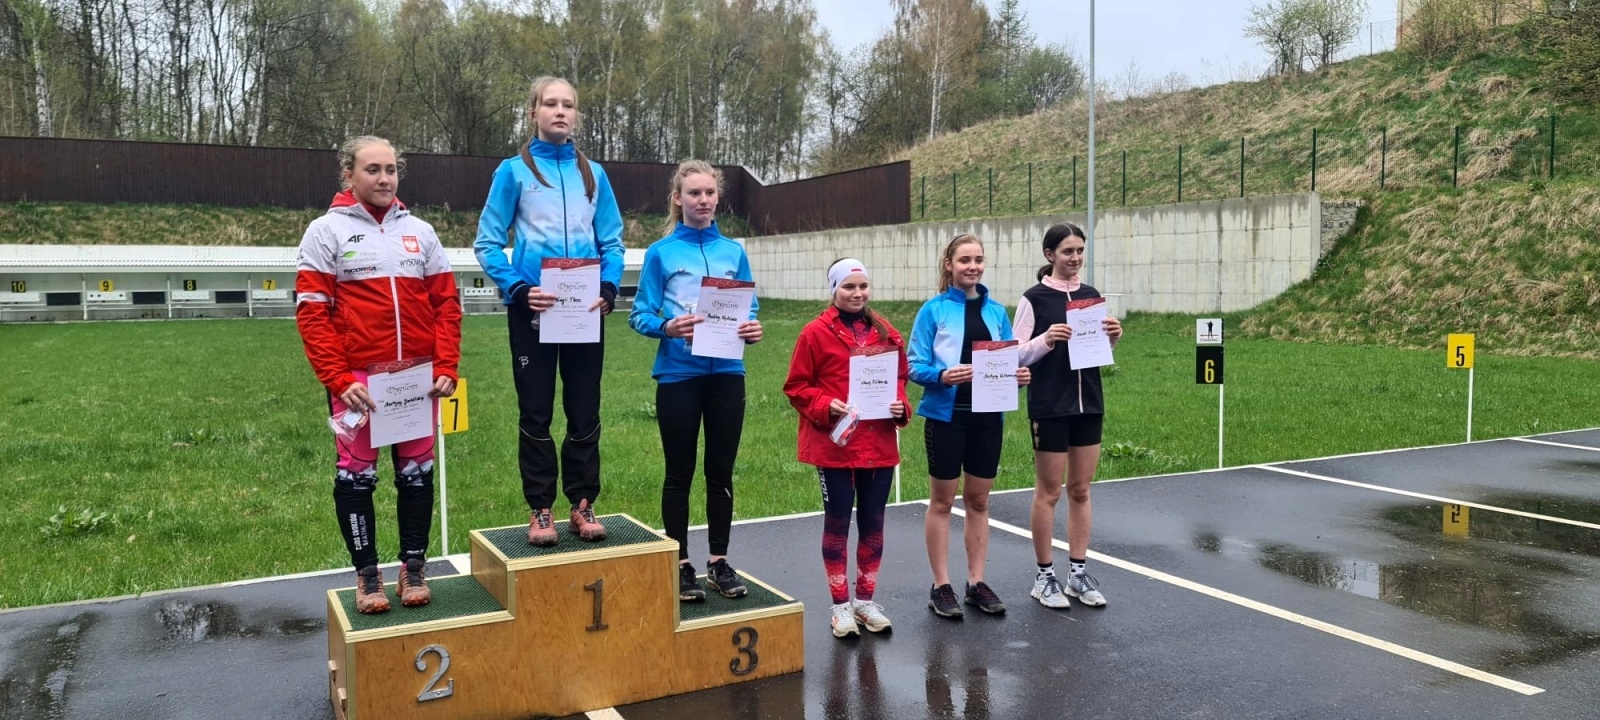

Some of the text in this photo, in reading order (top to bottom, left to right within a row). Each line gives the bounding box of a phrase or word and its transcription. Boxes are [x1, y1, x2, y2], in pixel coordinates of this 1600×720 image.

[12, 281, 25, 292] 10
[102, 281, 109, 291] 9
[186, 280, 193, 290] 8
[265, 279, 272, 290] 7
[475, 279, 482, 288] 4
[1456, 345, 1465, 367] 5
[1204, 359, 1215, 384] 6
[449, 398, 459, 431] 7
[583, 579, 609, 632] 1
[729, 626, 760, 676] 3
[414, 644, 454, 702] 2
